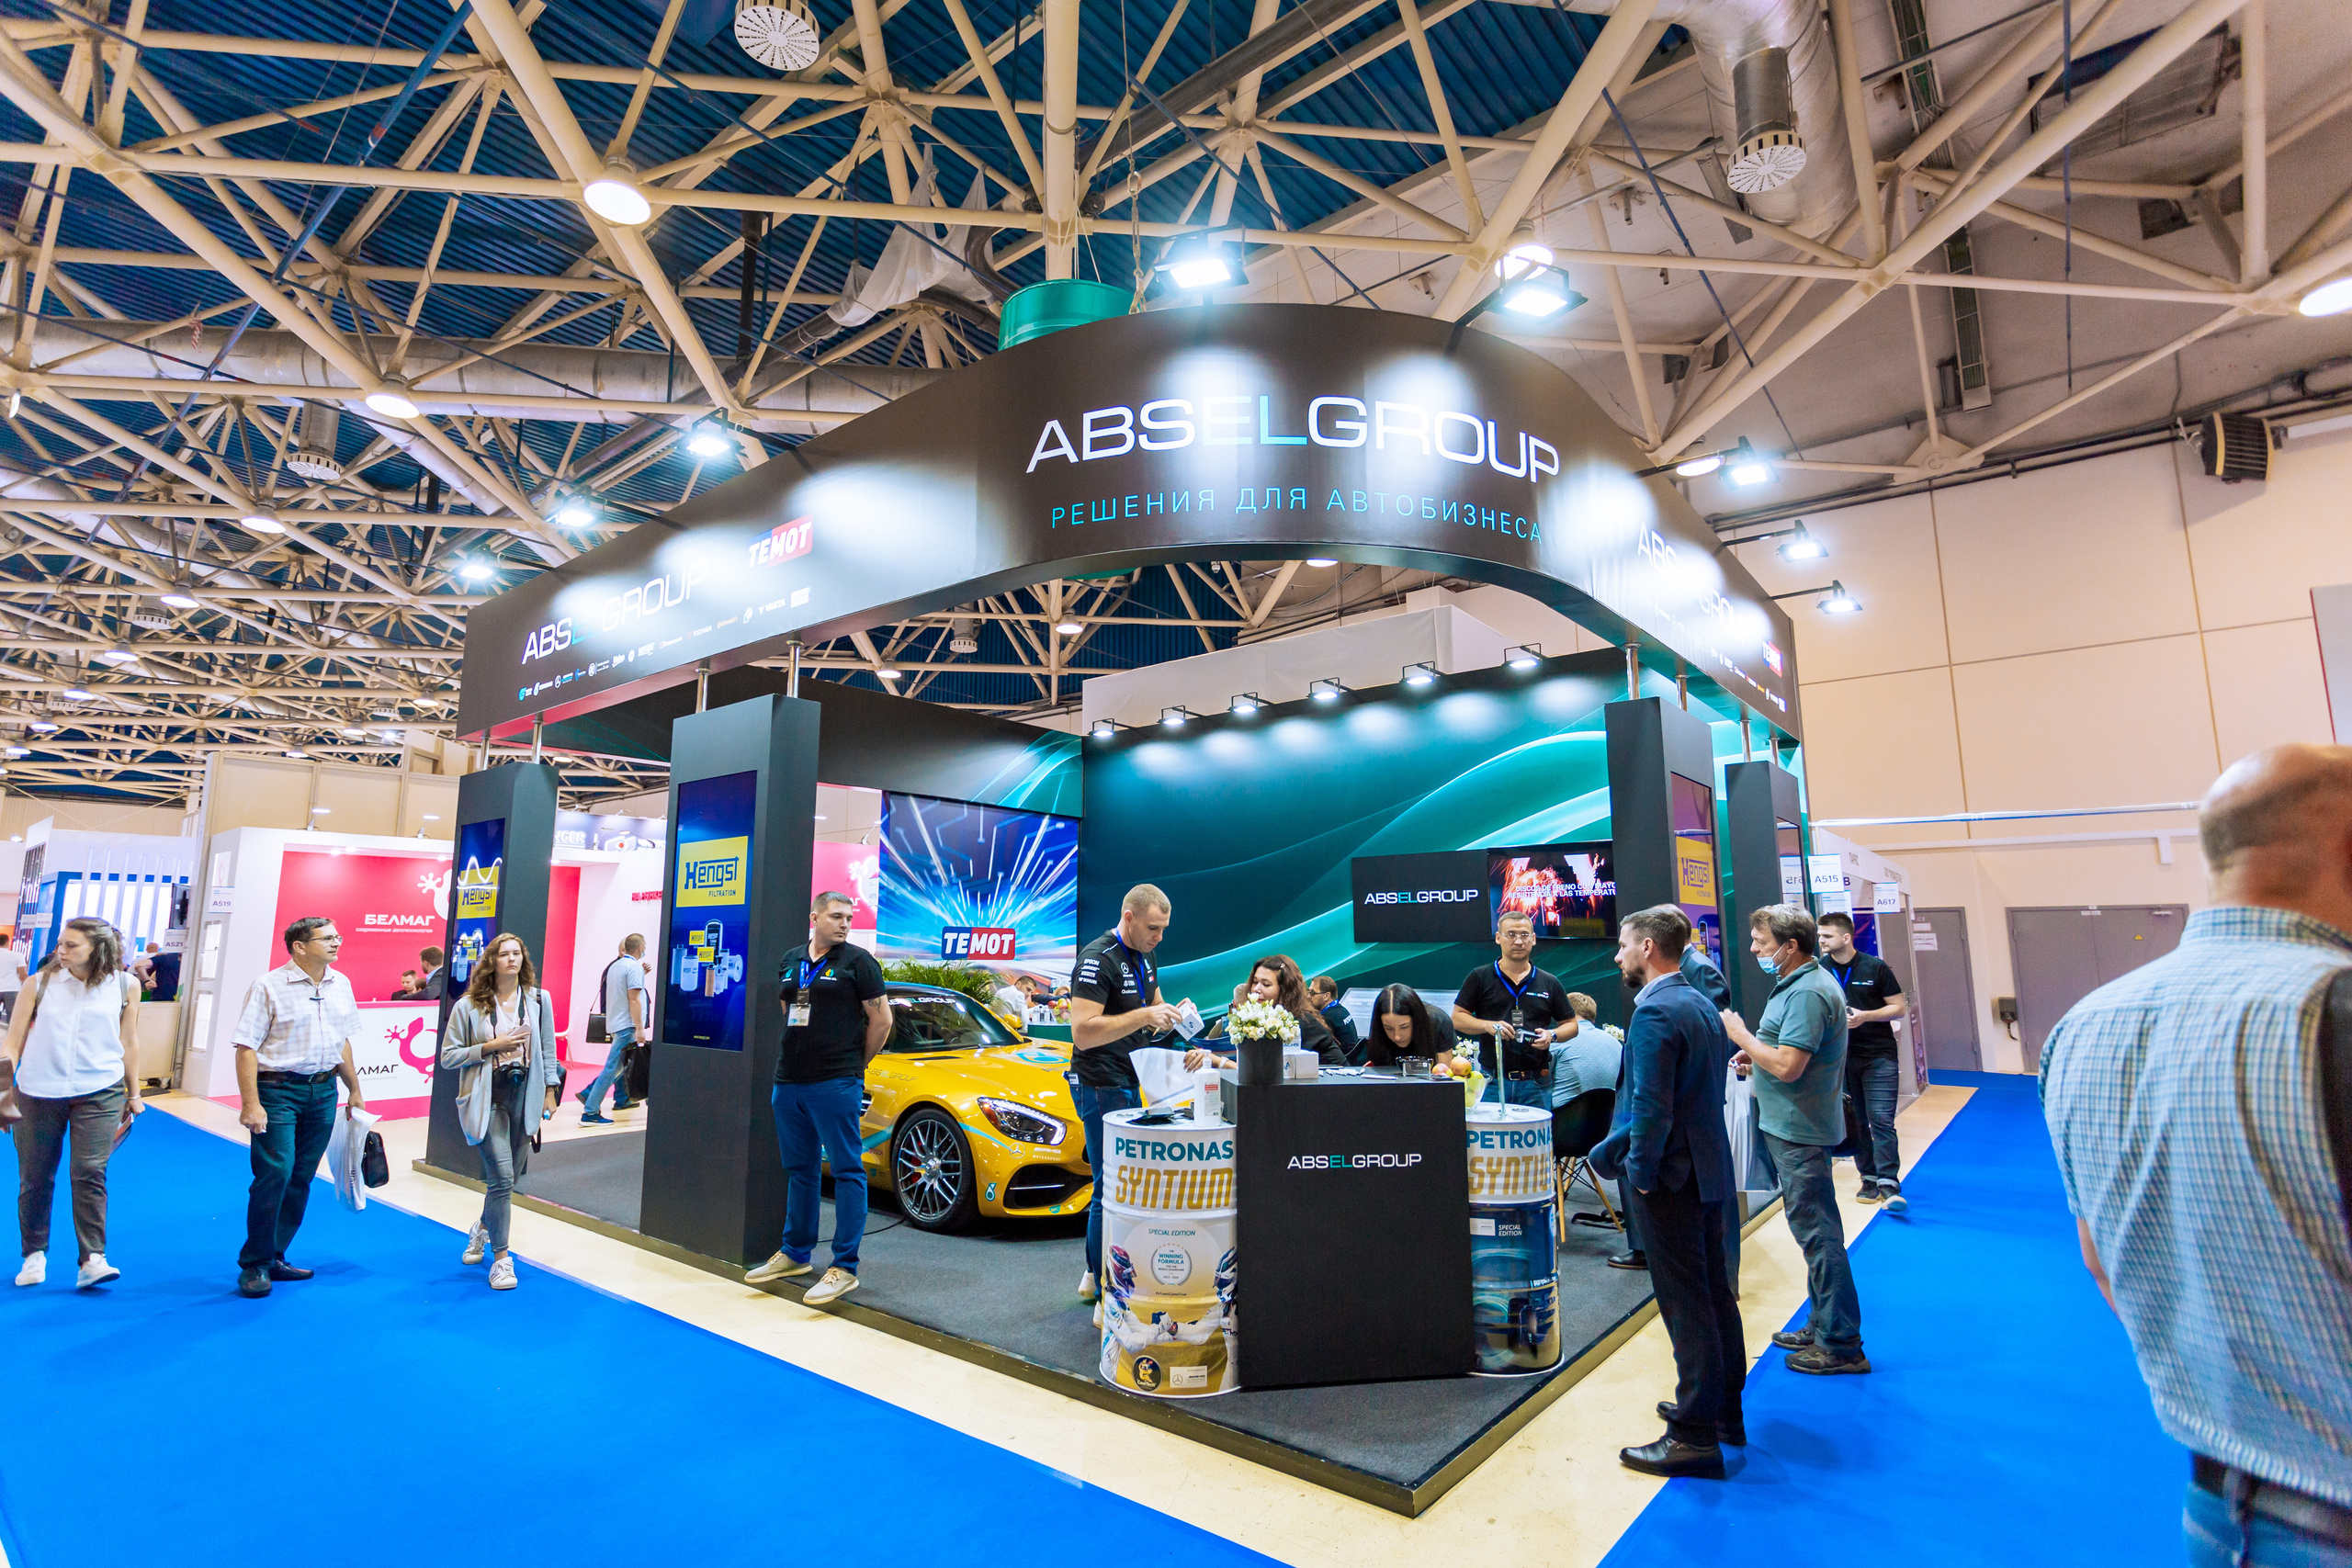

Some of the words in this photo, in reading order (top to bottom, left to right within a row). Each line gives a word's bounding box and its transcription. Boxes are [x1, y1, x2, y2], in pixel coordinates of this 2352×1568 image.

[1026, 395, 1560, 483] ABSELGROUP
[1051, 489, 1216, 529] РЕШЕНИЯ
[1236, 487, 1307, 514] ДЛЯ
[1326, 489, 1543, 544] АВТОБИЗНЕСА
[749, 521, 812, 568] TEMOT
[1815, 875, 1838, 884] A515
[708, 889, 737, 897] FILTRATION
[1364, 889, 1478, 905] ABSELGROUP
[365, 914, 435, 926] БЕЛМАГ
[944, 932, 1014, 955] TEMOT
[888, 998, 956, 1006] BELGROUP
[356, 1064, 399, 1076] ЛМАГ
[1465, 1126, 1553, 1149] PETRONA
[1115, 1137, 1234, 1161] PETRONAS
[1287, 1154, 1422, 1169] ABSELGROUP
[1115, 1165, 1233, 1211] SYNTIUM
